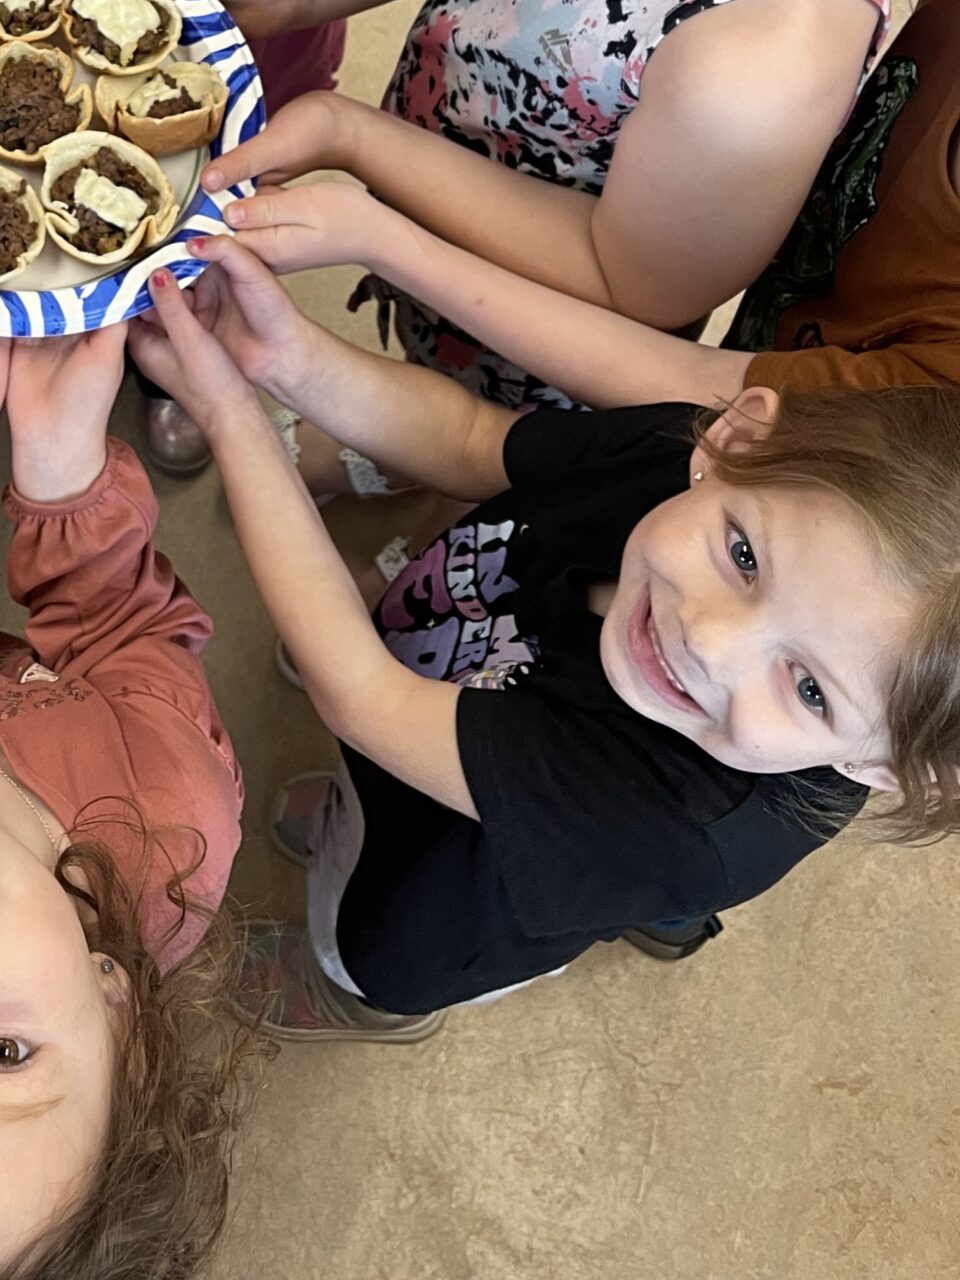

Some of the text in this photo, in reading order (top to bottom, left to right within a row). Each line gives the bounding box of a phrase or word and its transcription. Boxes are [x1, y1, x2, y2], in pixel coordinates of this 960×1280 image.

[447, 525, 492, 682] KINDER
[476, 520, 535, 669] IN M
